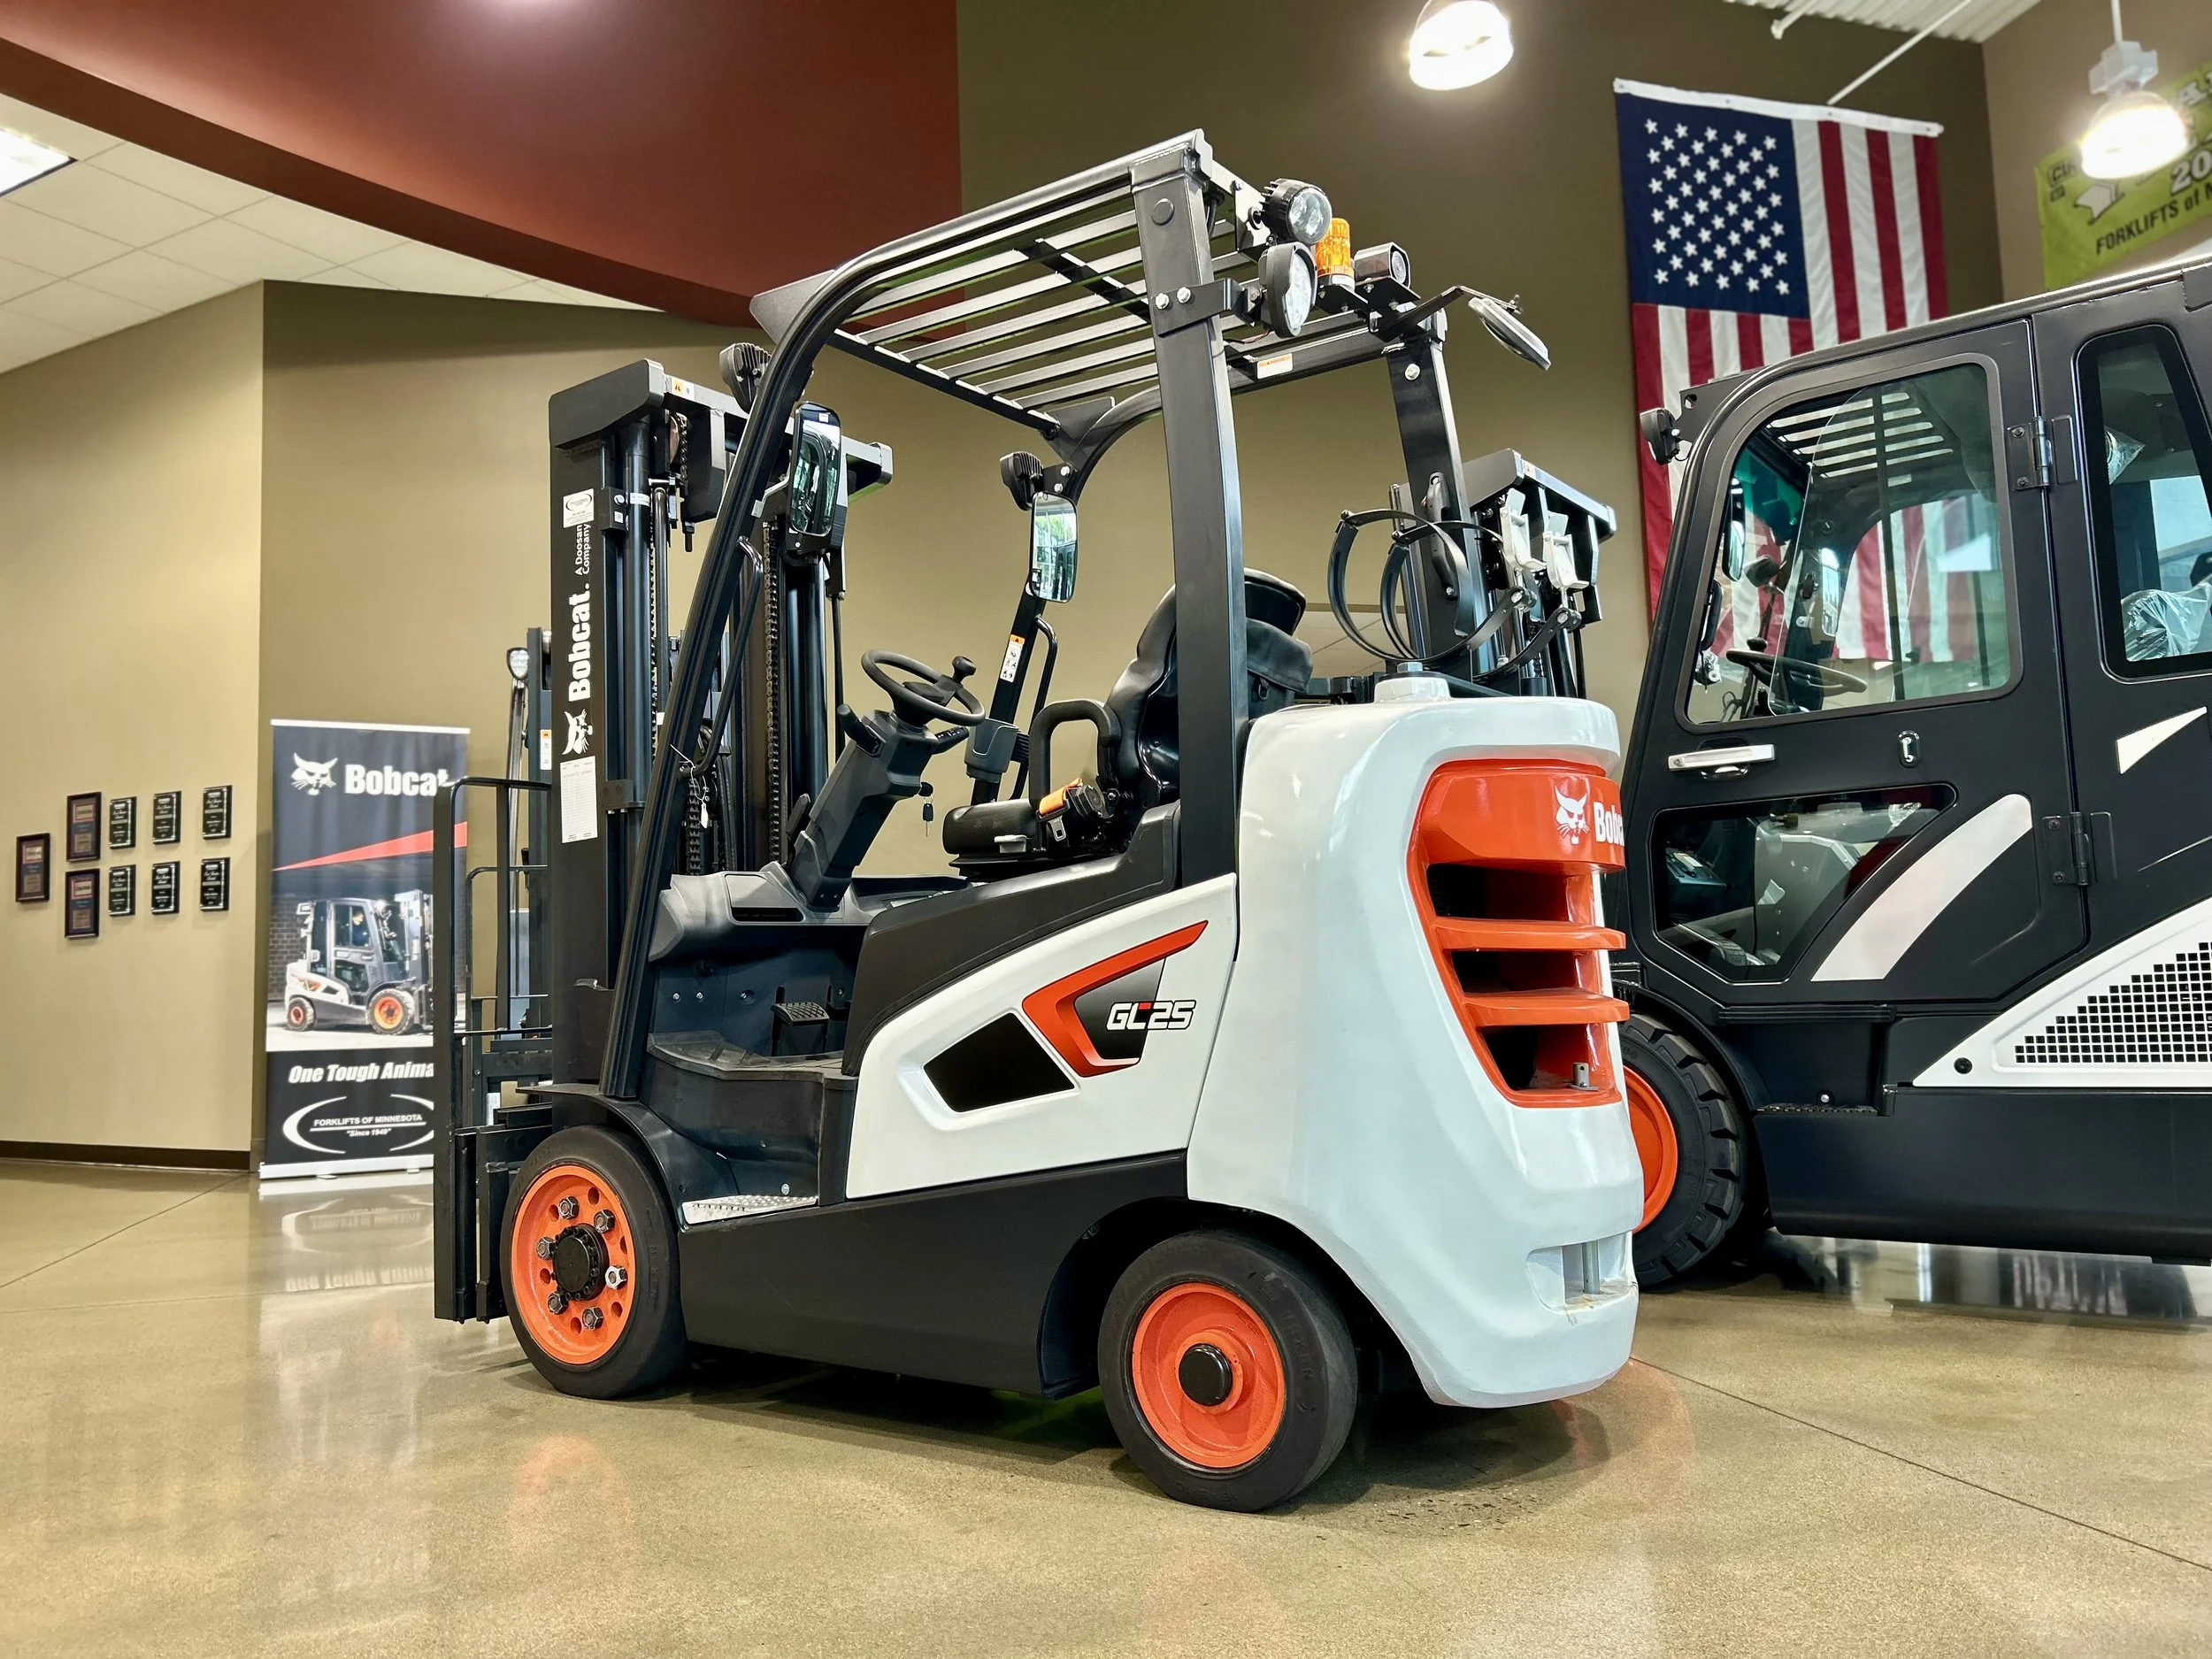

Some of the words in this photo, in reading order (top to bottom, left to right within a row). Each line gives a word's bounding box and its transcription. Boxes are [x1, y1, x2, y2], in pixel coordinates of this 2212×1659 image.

[2096, 200, 2179, 256] FORKLIFTS
[582, 524, 591, 575] Company
[1106, 1000, 1197, 1031] GL25
[288, 1064, 325, 1084] One
[326, 1063, 380, 1083] Tough
[313, 1117, 361, 1127] FORKLIFTS
[361, 1116, 374, 1125] OF
[374, 1113, 423, 1124] MINNESOTA
